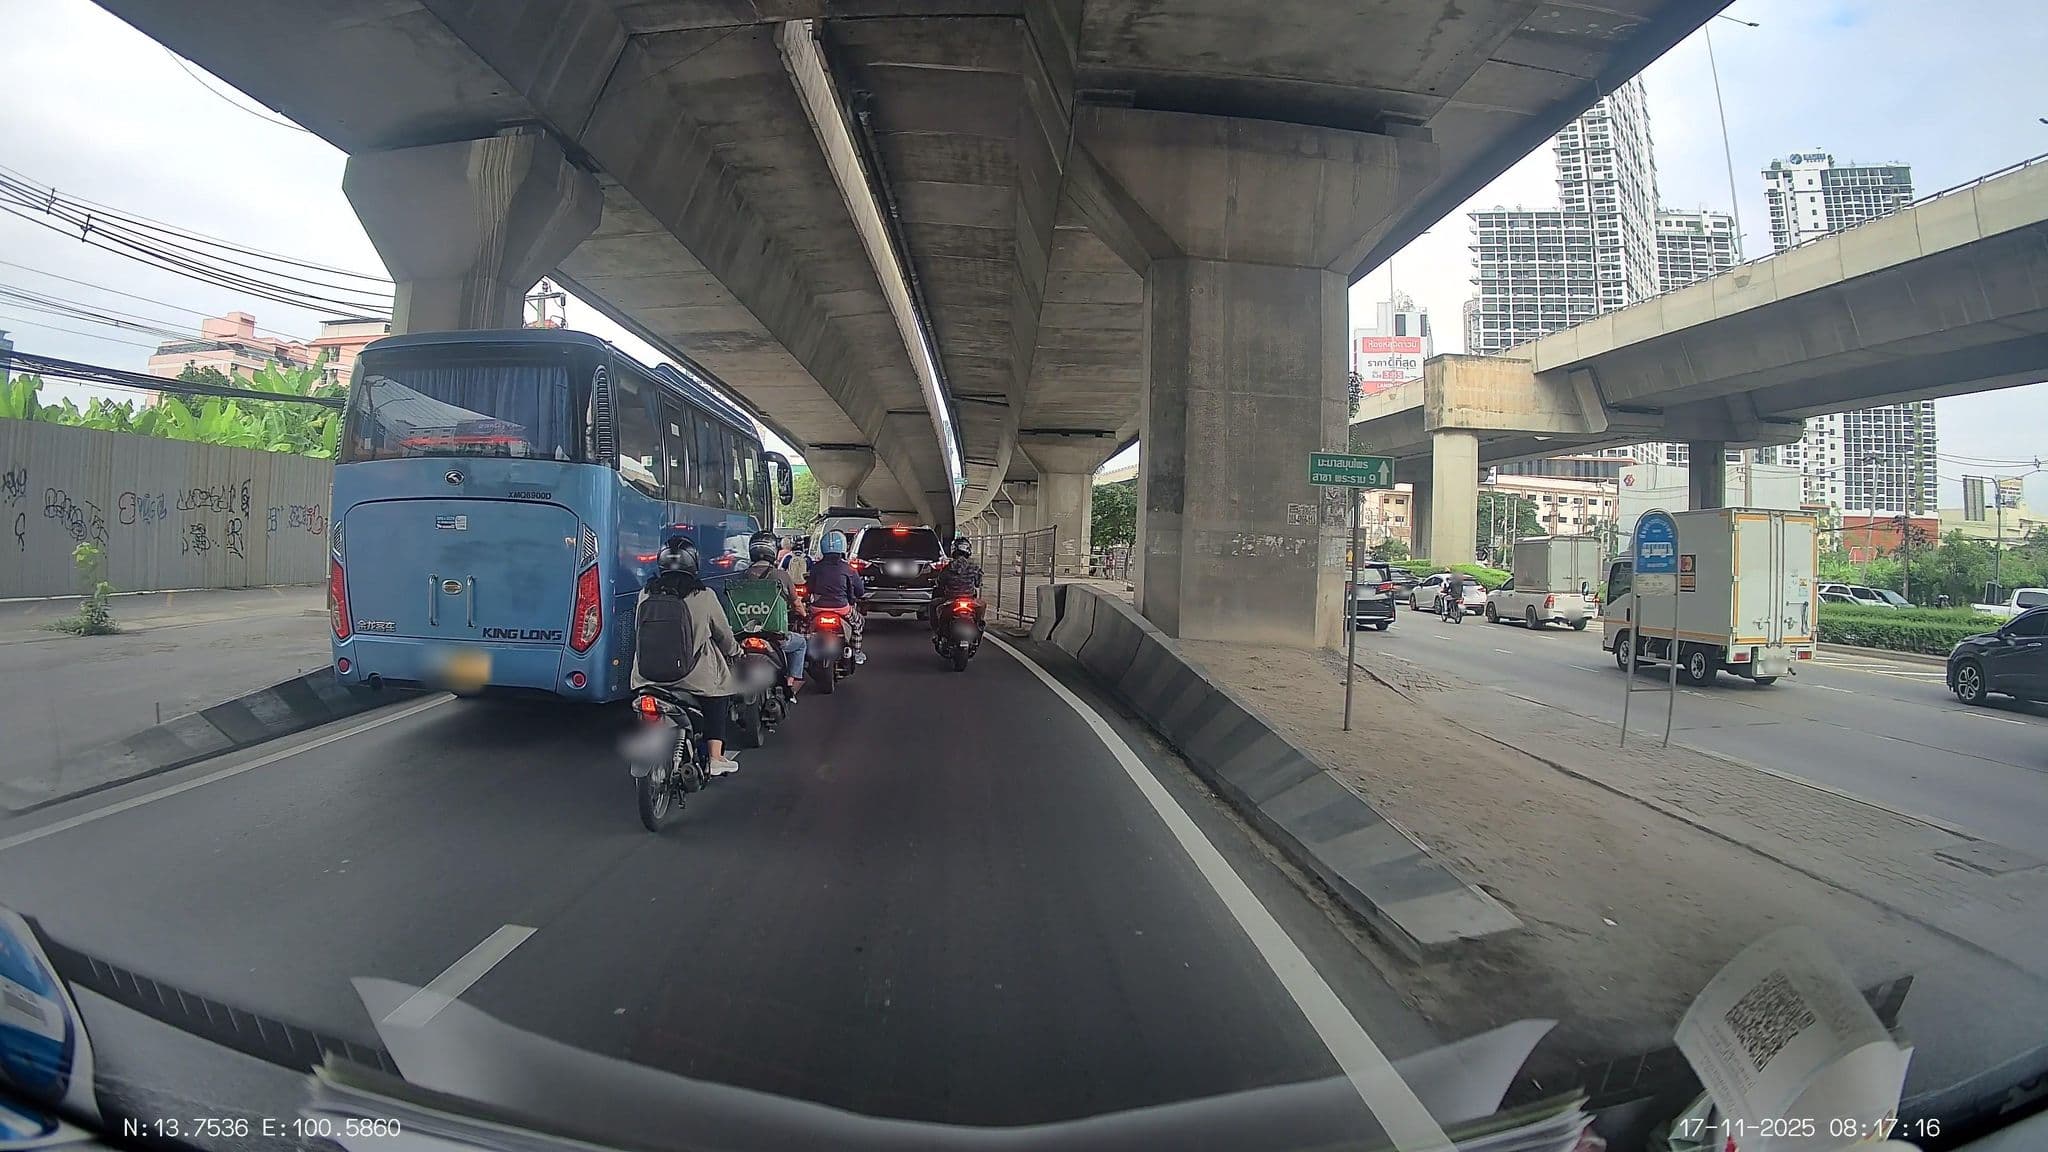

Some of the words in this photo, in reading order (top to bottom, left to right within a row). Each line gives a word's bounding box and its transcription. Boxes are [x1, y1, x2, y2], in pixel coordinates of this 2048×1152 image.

[1368, 473, 1377, 484] 9
[737, 602, 770, 615] Grab
[482, 627, 518, 639] KING
[519, 629, 563, 641] LONG
